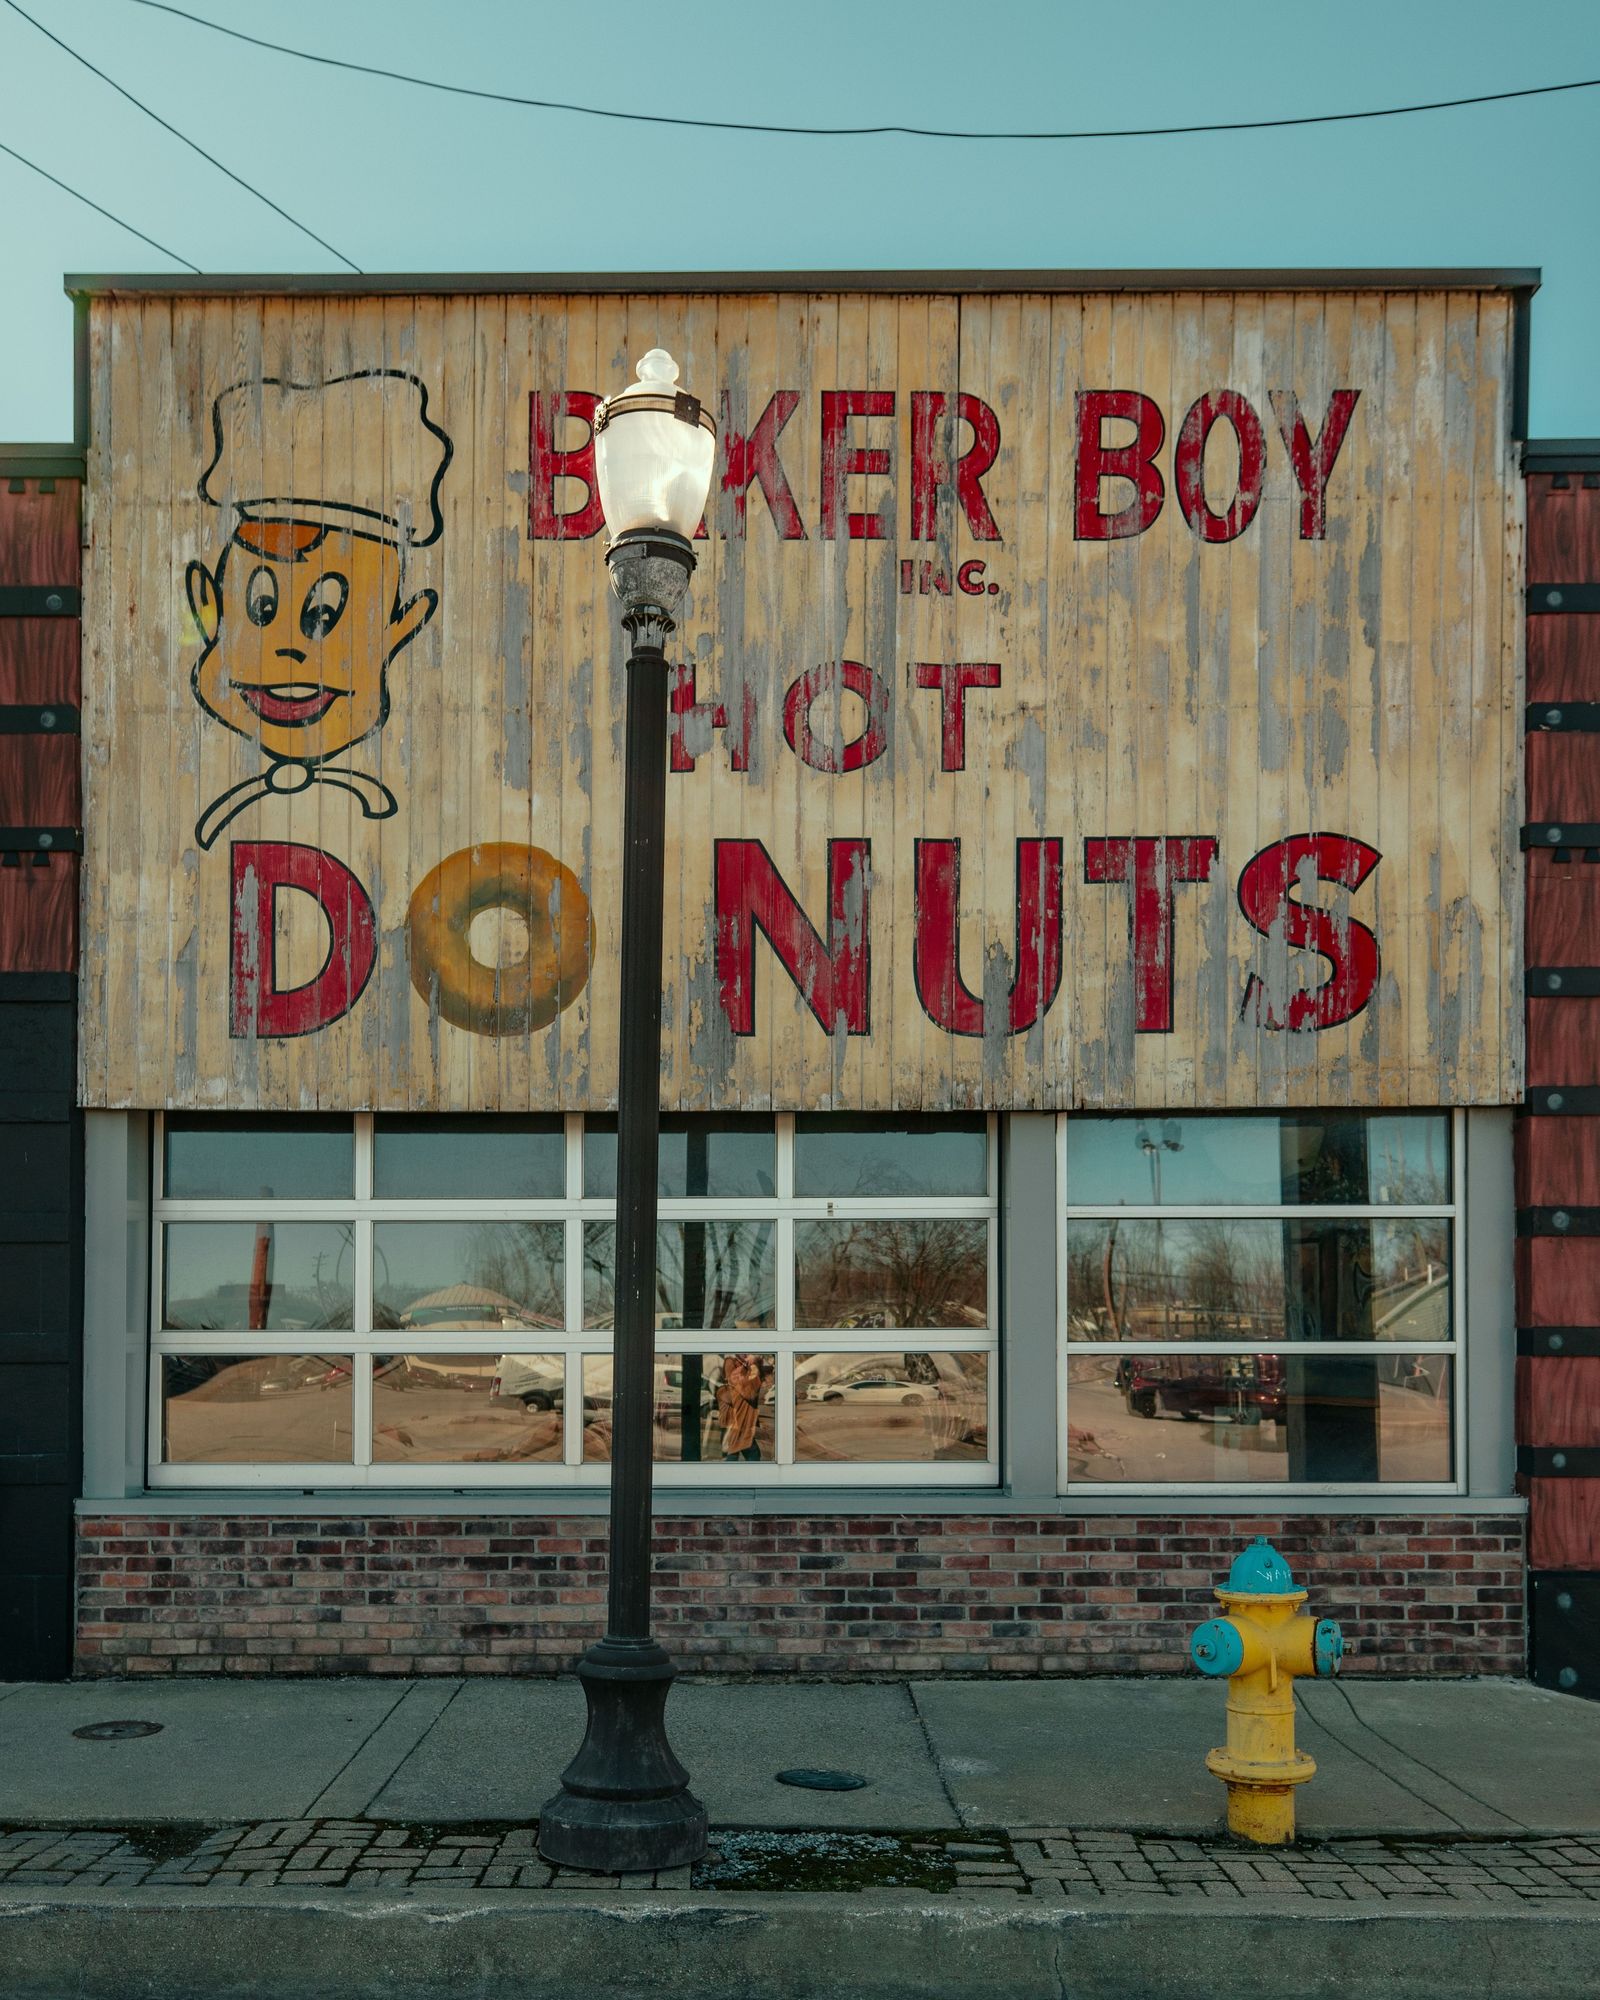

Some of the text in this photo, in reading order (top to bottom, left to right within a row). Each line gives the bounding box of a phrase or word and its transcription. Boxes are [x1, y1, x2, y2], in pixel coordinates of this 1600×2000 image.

[528, 389, 1361, 543] BKER BOY
[900, 559, 1000, 596] INC.
[670, 660, 1001, 773] HOT
